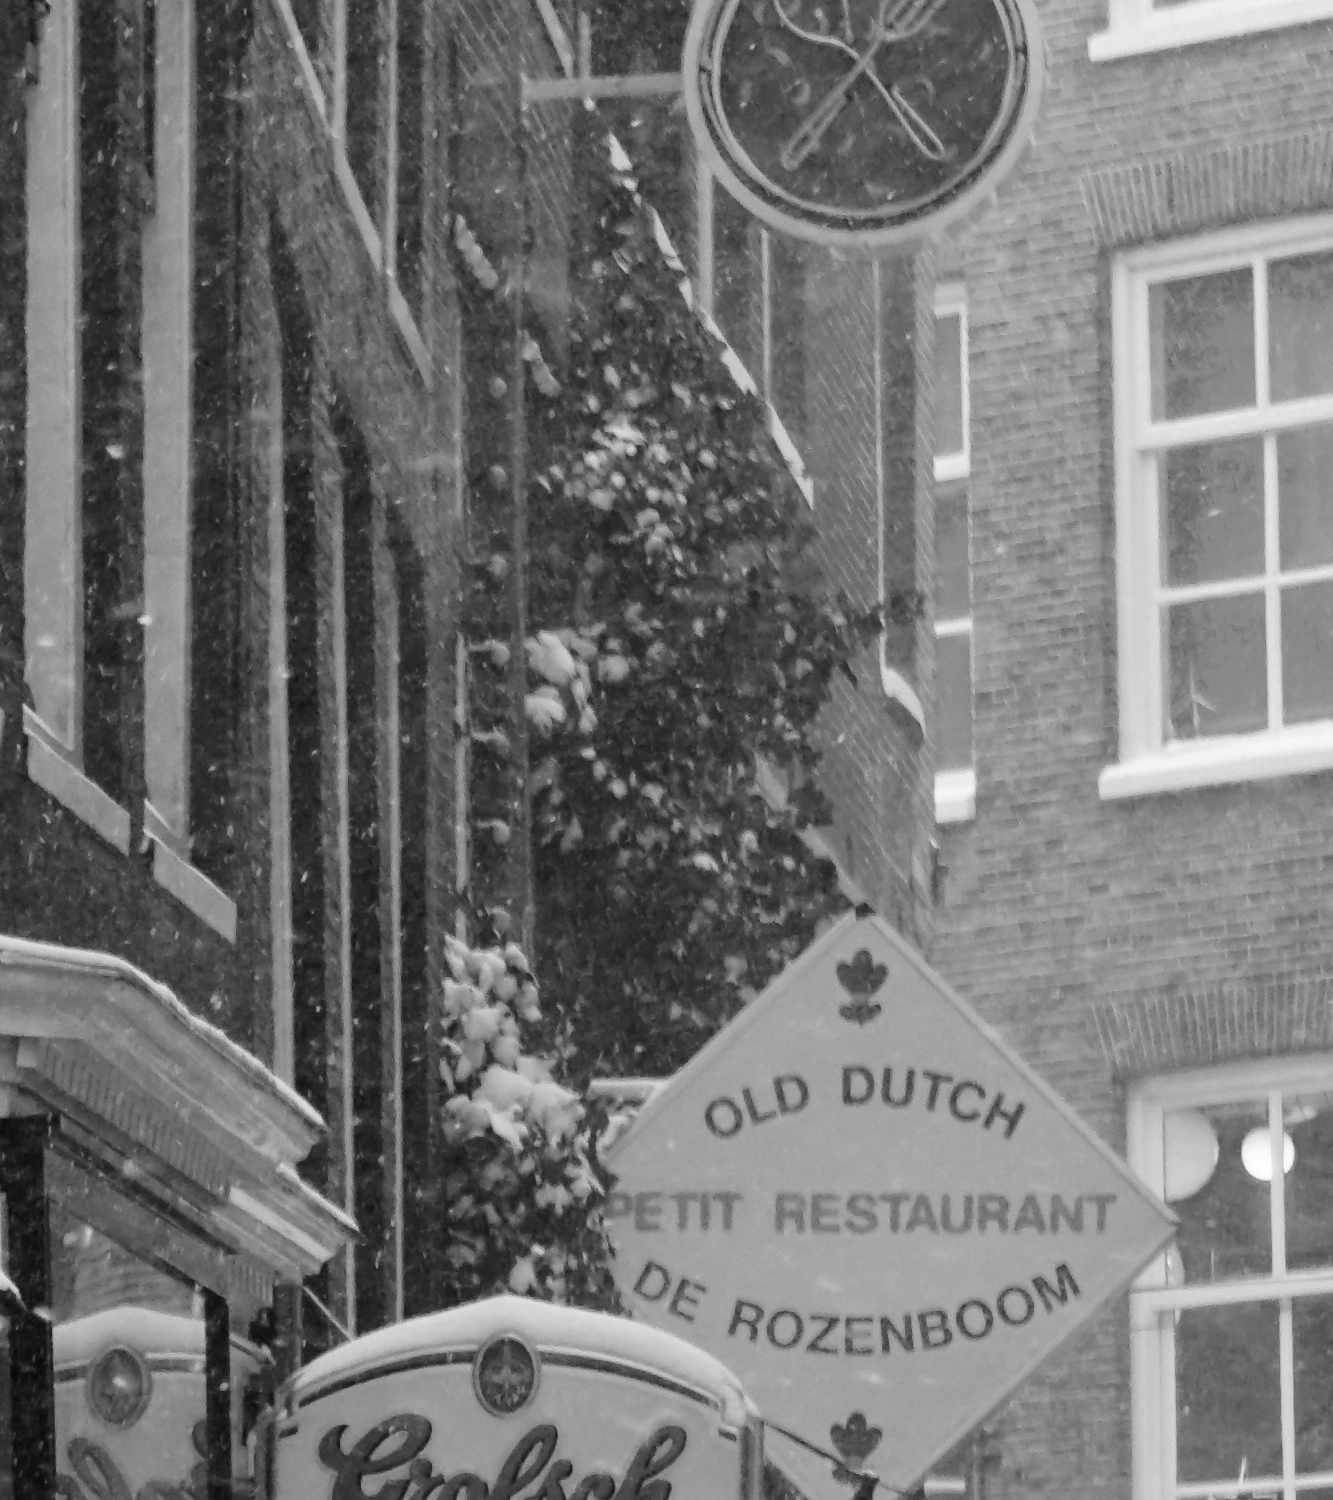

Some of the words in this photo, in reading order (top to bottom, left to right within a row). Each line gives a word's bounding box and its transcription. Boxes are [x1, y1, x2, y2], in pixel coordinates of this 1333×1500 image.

[704, 1074, 810, 1139] OLD
[841, 1064, 1026, 1139] DUTCH
[774, 1192, 1118, 1235] RESTAURANT
[633, 1259, 708, 1323] DE
[726, 1262, 1082, 1357] ROZENBOOM
